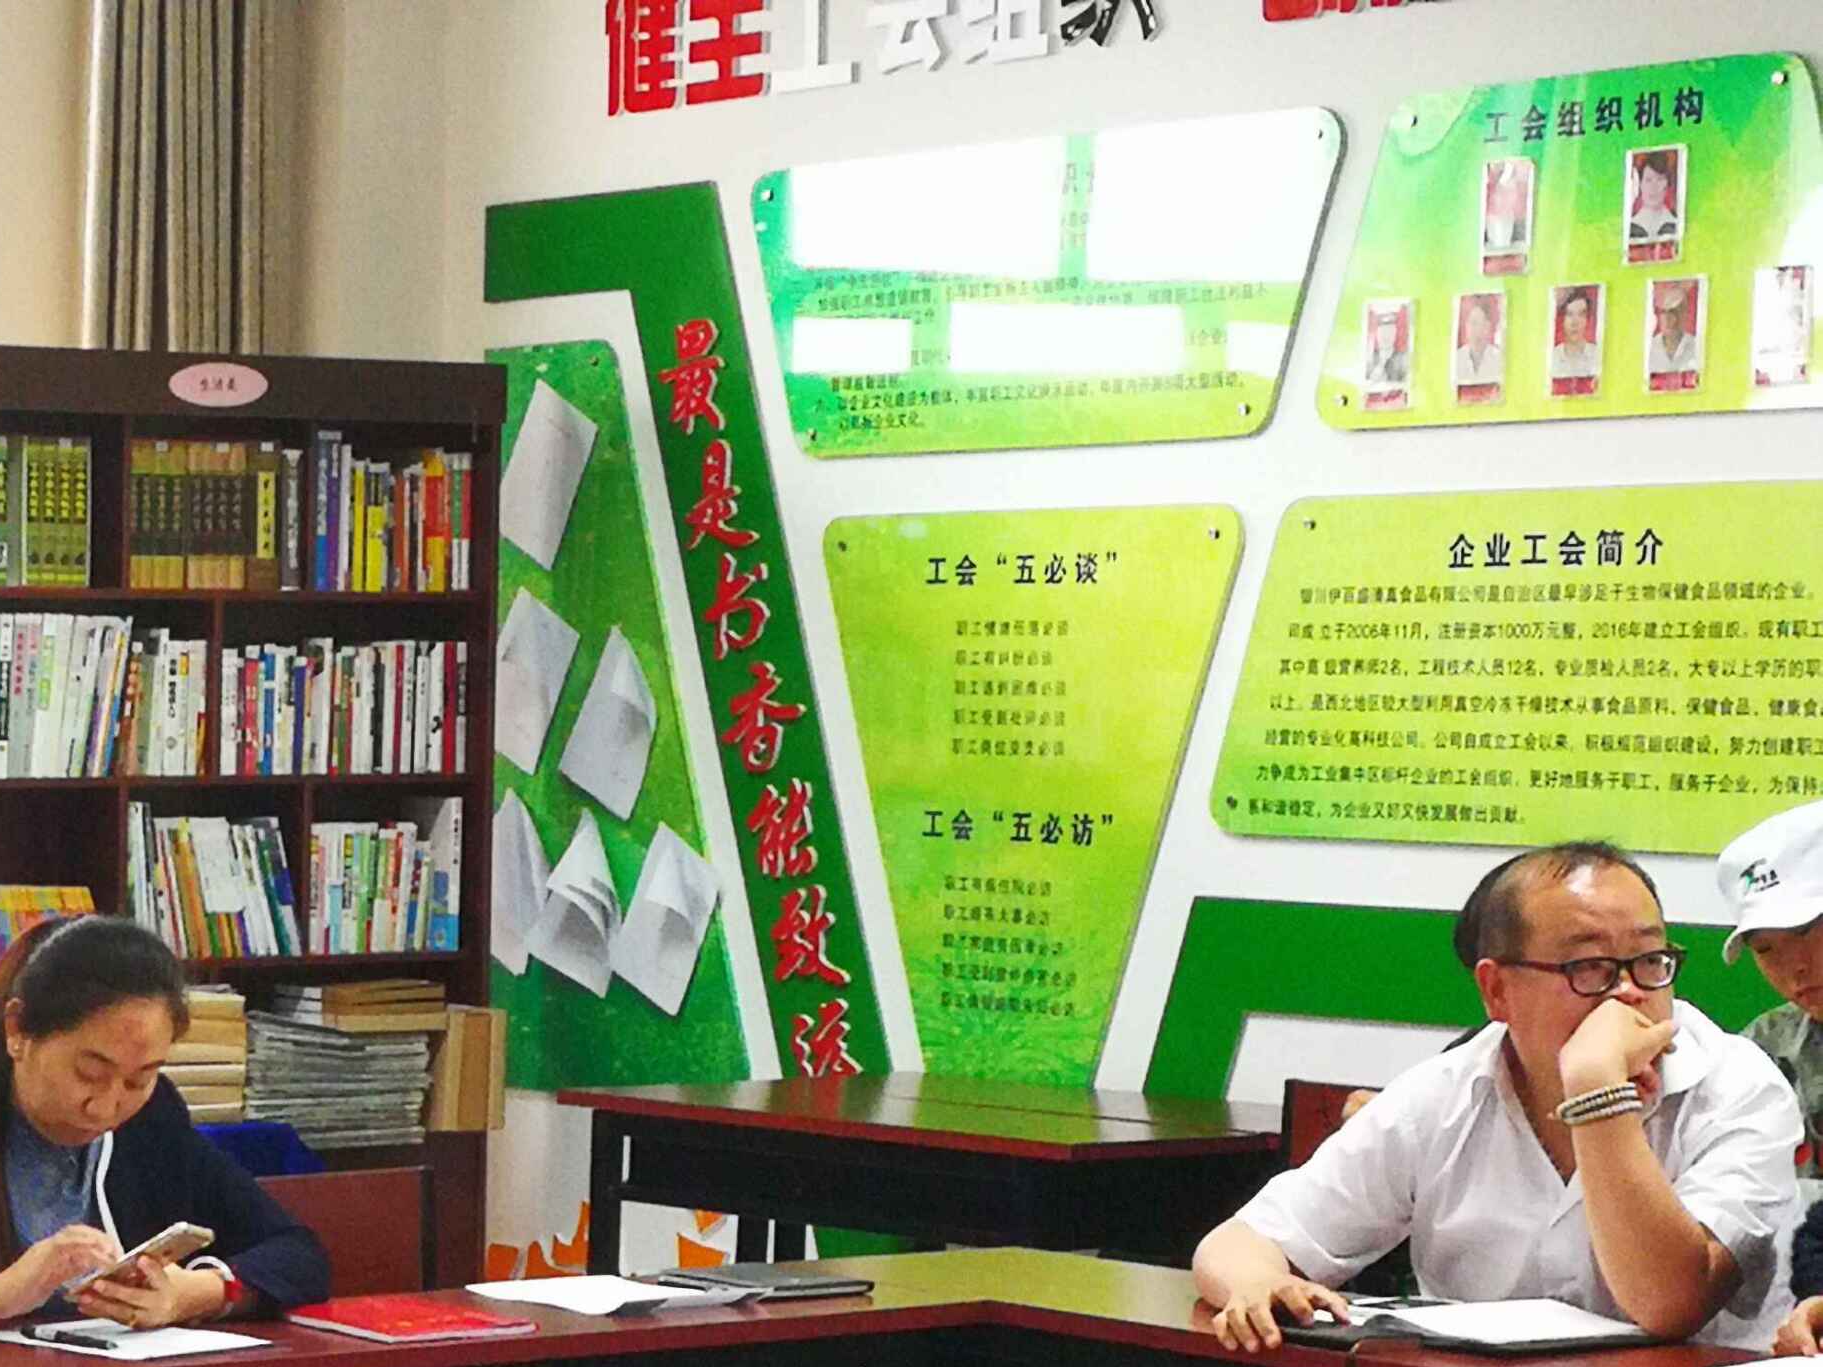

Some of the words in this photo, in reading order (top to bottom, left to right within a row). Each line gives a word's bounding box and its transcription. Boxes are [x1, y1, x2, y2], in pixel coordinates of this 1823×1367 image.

[1483, 87, 1705, 144] 工会组织机构
[1448, 528, 1664, 568] 企业工会简介
